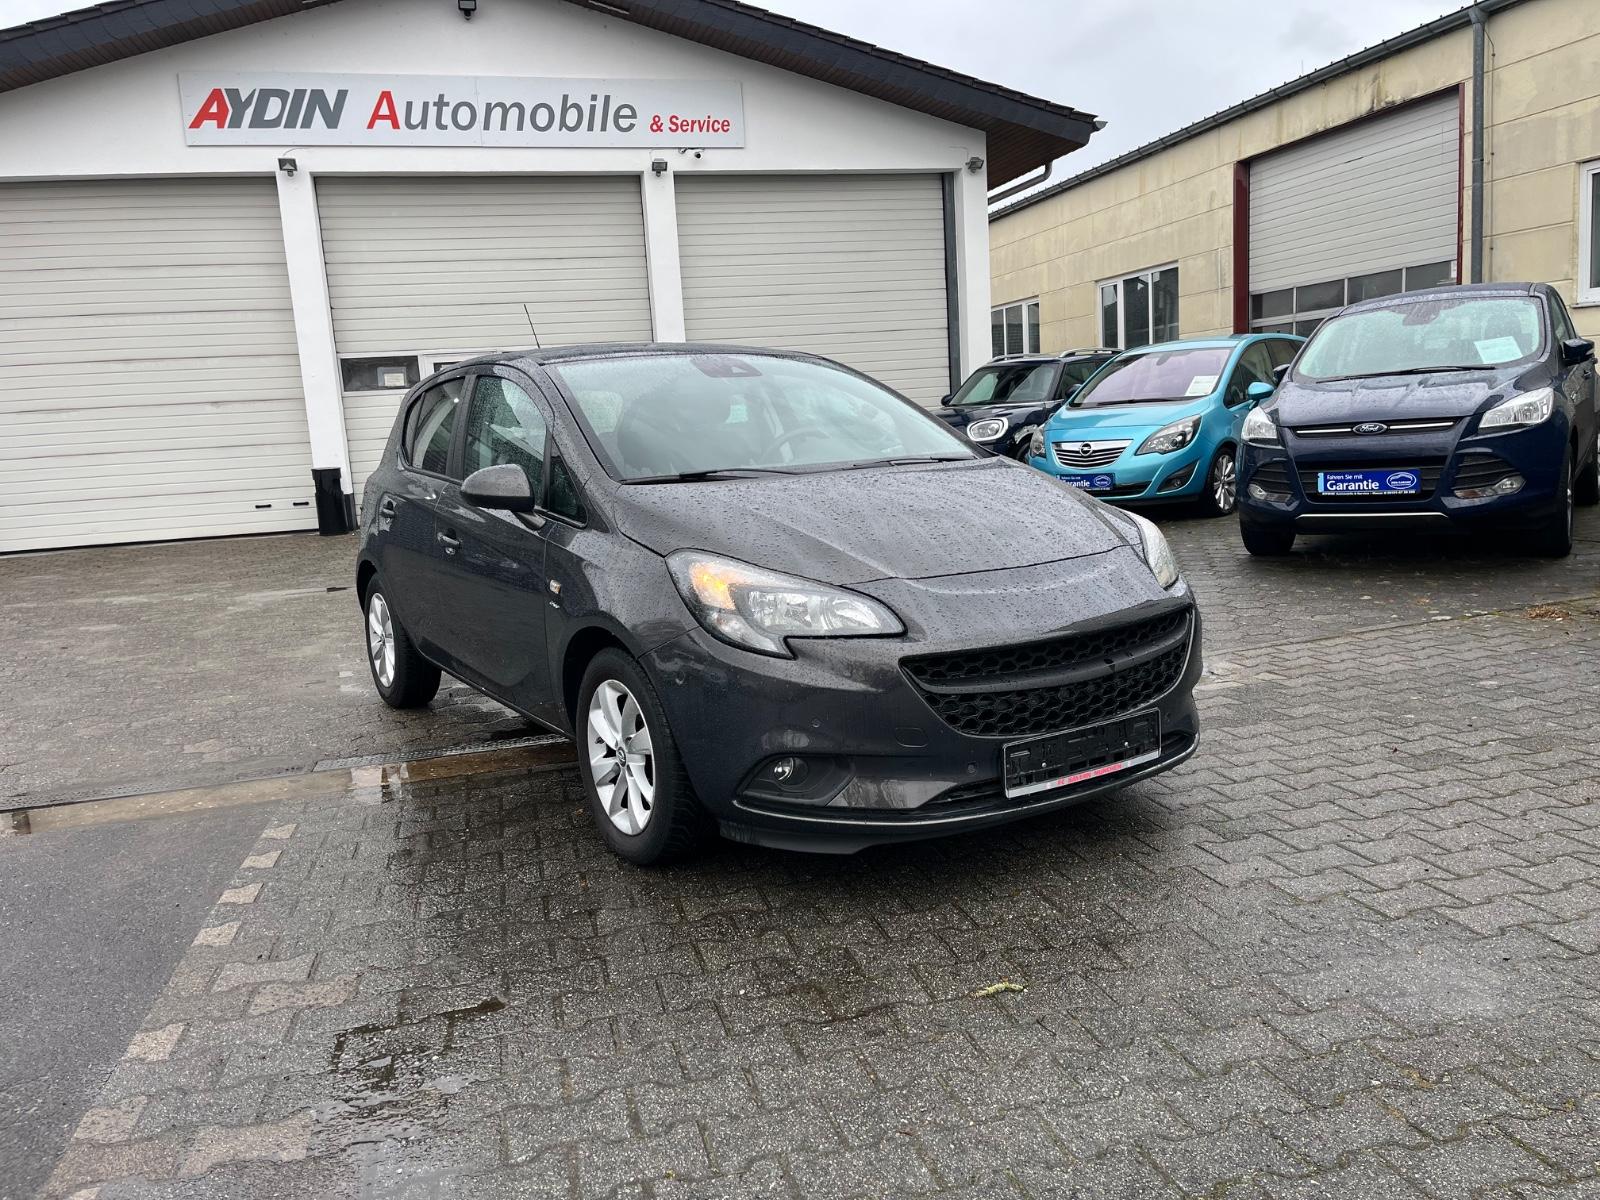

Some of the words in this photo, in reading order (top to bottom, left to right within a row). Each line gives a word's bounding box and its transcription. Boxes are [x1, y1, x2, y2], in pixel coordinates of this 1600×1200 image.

[189, 88, 349, 130] AYDIN
[366, 90, 638, 132] Automobile
[650, 115, 663, 132] &
[669, 115, 730, 132] Service
[1327, 479, 1379, 490] Garantie
